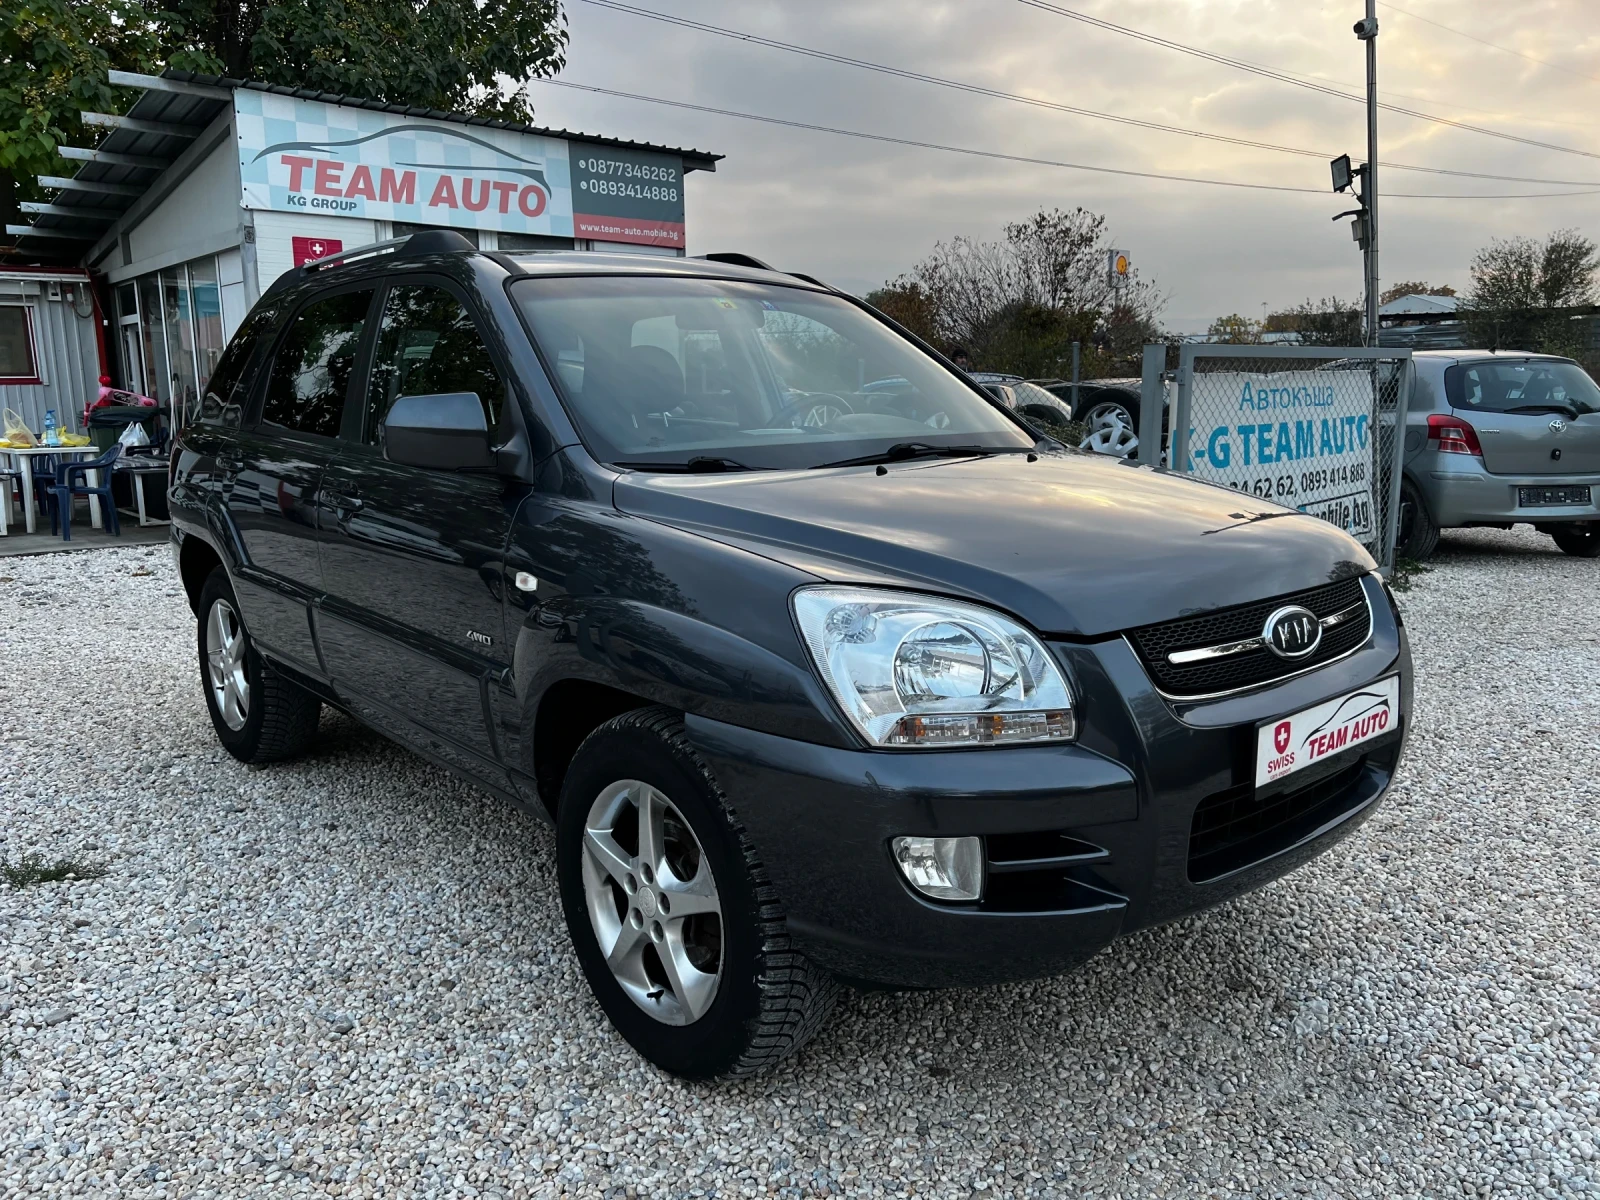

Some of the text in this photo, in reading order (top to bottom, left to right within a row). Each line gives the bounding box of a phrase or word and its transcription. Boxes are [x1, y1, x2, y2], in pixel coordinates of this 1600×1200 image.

[588, 158, 676, 182] 0877346262
[281, 154, 547, 218] TEAM AUTO
[589, 179, 678, 202] 0893414888
[287, 194, 357, 211] KG GROUP
[579, 223, 678, 240] www.team-auto.mobile.bg
[1239, 381, 1334, 411] Автокъща
[1237, 419, 1314, 466] TEAM
[1319, 414, 1368, 457] AUTO
[1301, 469, 1327, 493] 0893
[1329, 465, 1348, 487] 414
[1350, 462, 1365, 484] 888
[466, 630, 492, 645] 4WD
[1308, 709, 1389, 760] TEAM AUTO
[1267, 751, 1295, 774] SWISS
